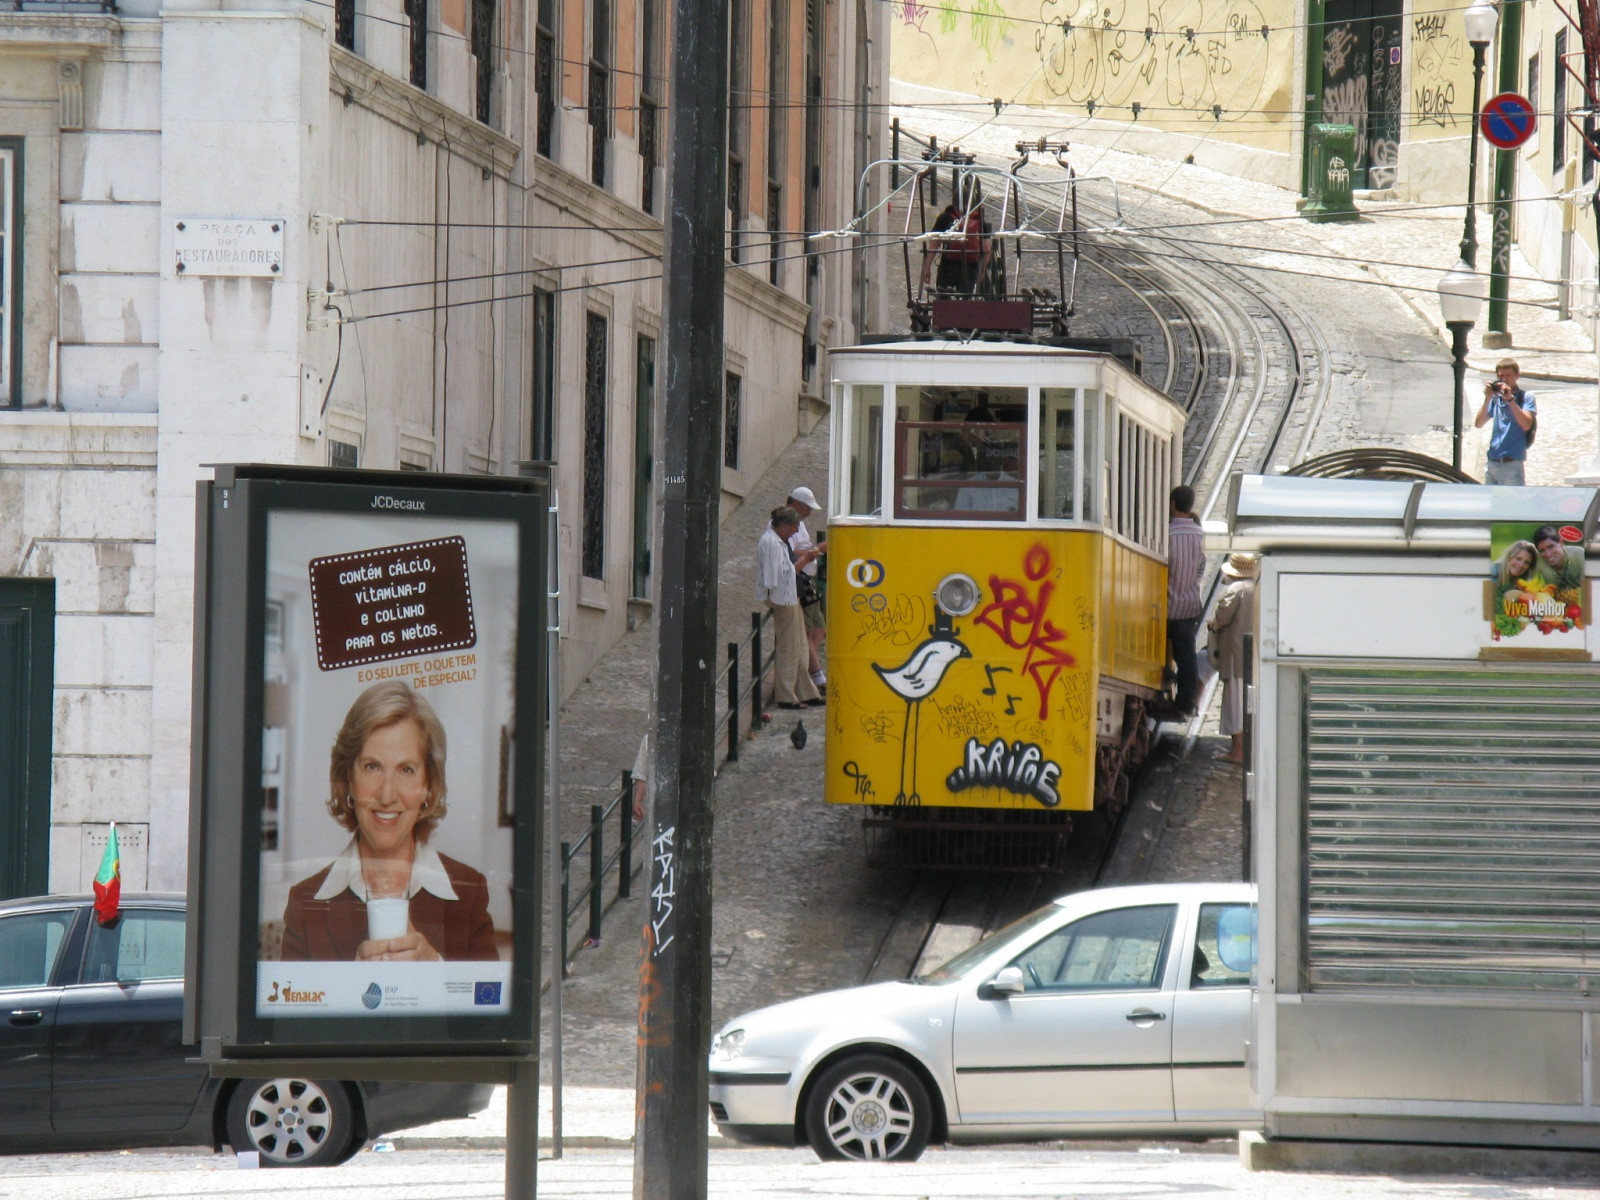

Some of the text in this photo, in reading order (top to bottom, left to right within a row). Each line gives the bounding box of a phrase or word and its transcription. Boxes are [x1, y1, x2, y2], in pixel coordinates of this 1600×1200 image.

[200, 224, 256, 237] PRAÇA
[175, 249, 281, 263] RESTAURADORES
[371, 496, 425, 511] JCDecaux
[346, 634, 375, 651] PARA
[381, 631, 396, 645] OS
[358, 653, 476, 682] E O SEU LEITE, O QUE TEM
[413, 668, 477, 689] DE ESPECIAL?
